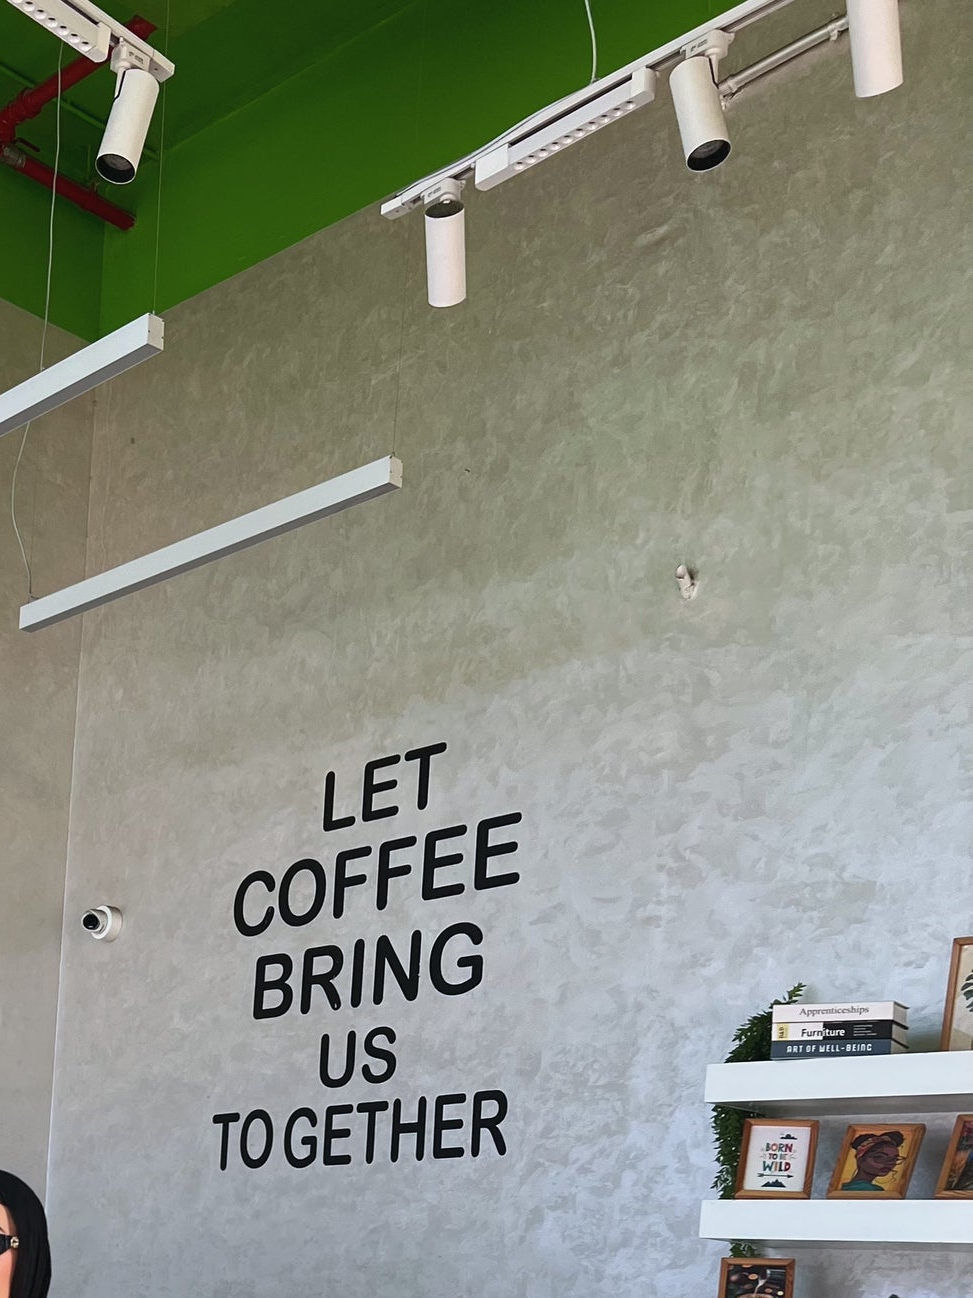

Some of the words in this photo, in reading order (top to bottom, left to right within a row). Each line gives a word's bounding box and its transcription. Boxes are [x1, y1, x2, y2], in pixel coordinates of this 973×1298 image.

[323, 741, 447, 832] LET
[233, 811, 522, 937] COFFEE
[253, 922, 483, 1020] BRING
[799, 1005, 869, 1017] Apprenticeships
[787, 1045, 803, 1053] ART
[806, 1044, 816, 1053] OF
[819, 1043, 872, 1053] WELL-BEING
[801, 1027, 846, 1037] Furniture
[319, 1026, 397, 1088] US
[212, 1089, 508, 1171] TOGETHER
[766, 1142, 793, 1152] BORN
[763, 1161, 791, 1172] WILD
